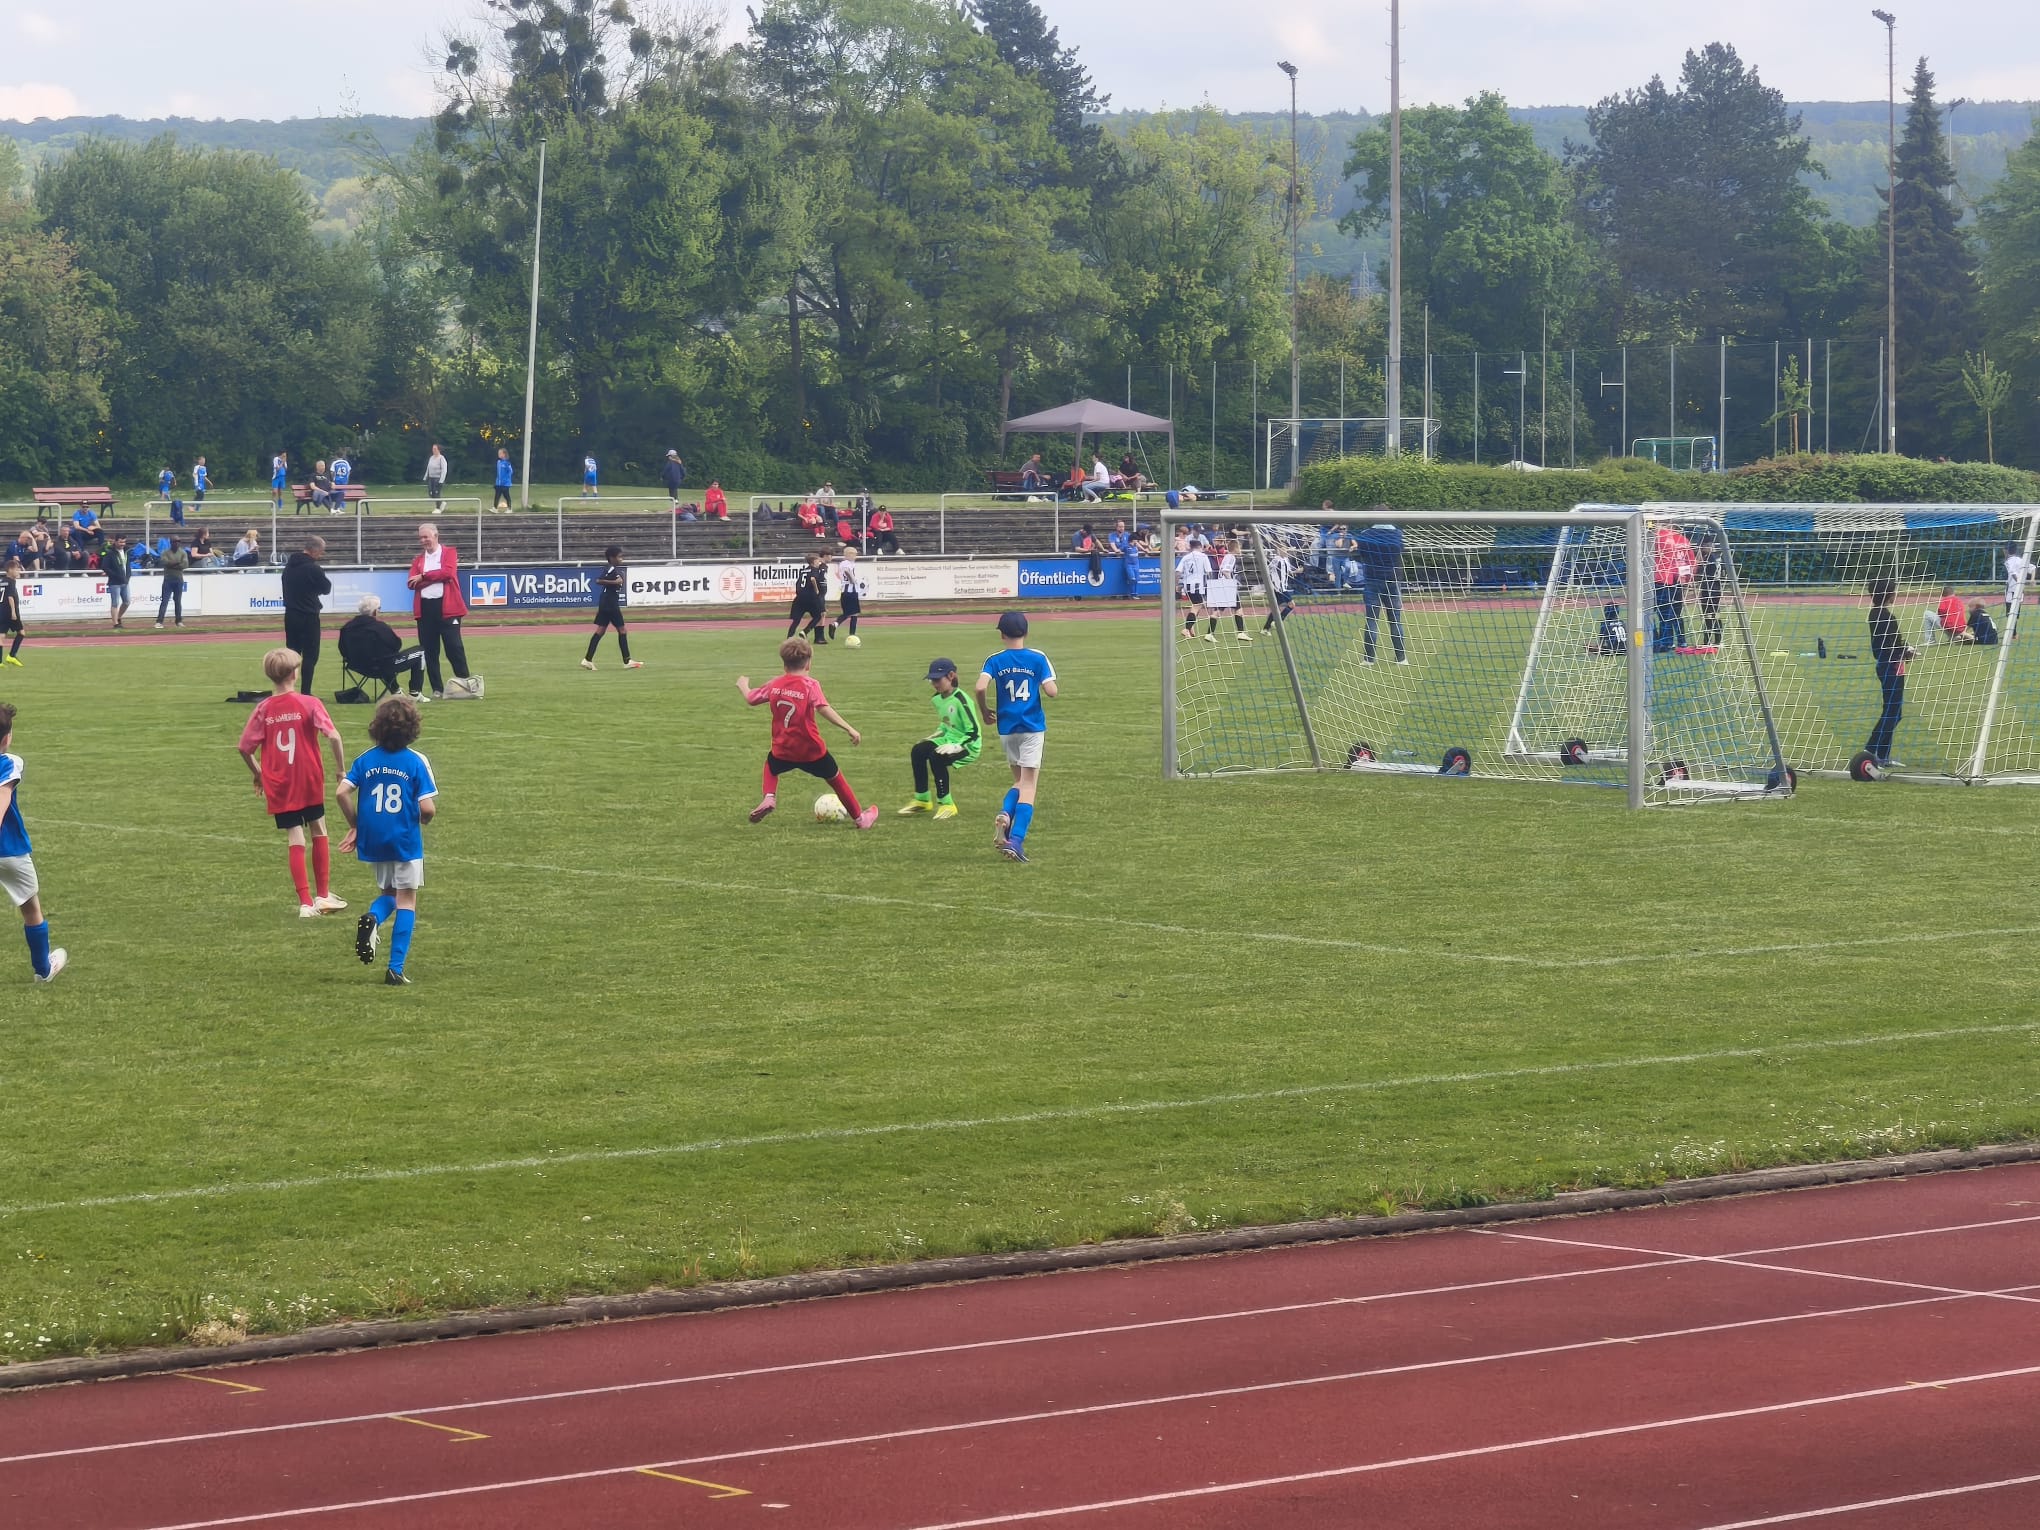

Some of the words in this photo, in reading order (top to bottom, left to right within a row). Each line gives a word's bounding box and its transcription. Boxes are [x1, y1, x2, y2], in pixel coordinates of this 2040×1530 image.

[511, 572, 592, 594] VR-Bank
[631, 577, 710, 595] expert
[800, 573, 807, 588] 5
[1020, 569, 1087, 585] Öffentliche
[250, 597, 285, 608] Holzmi
[522, 595, 582, 604] Südniedersachsen
[1005, 679, 1031, 702] 14
[777, 700, 796, 728] 7
[276, 727, 296, 765] 4
[365, 767, 381, 779] MTV
[371, 783, 403, 814] 18
